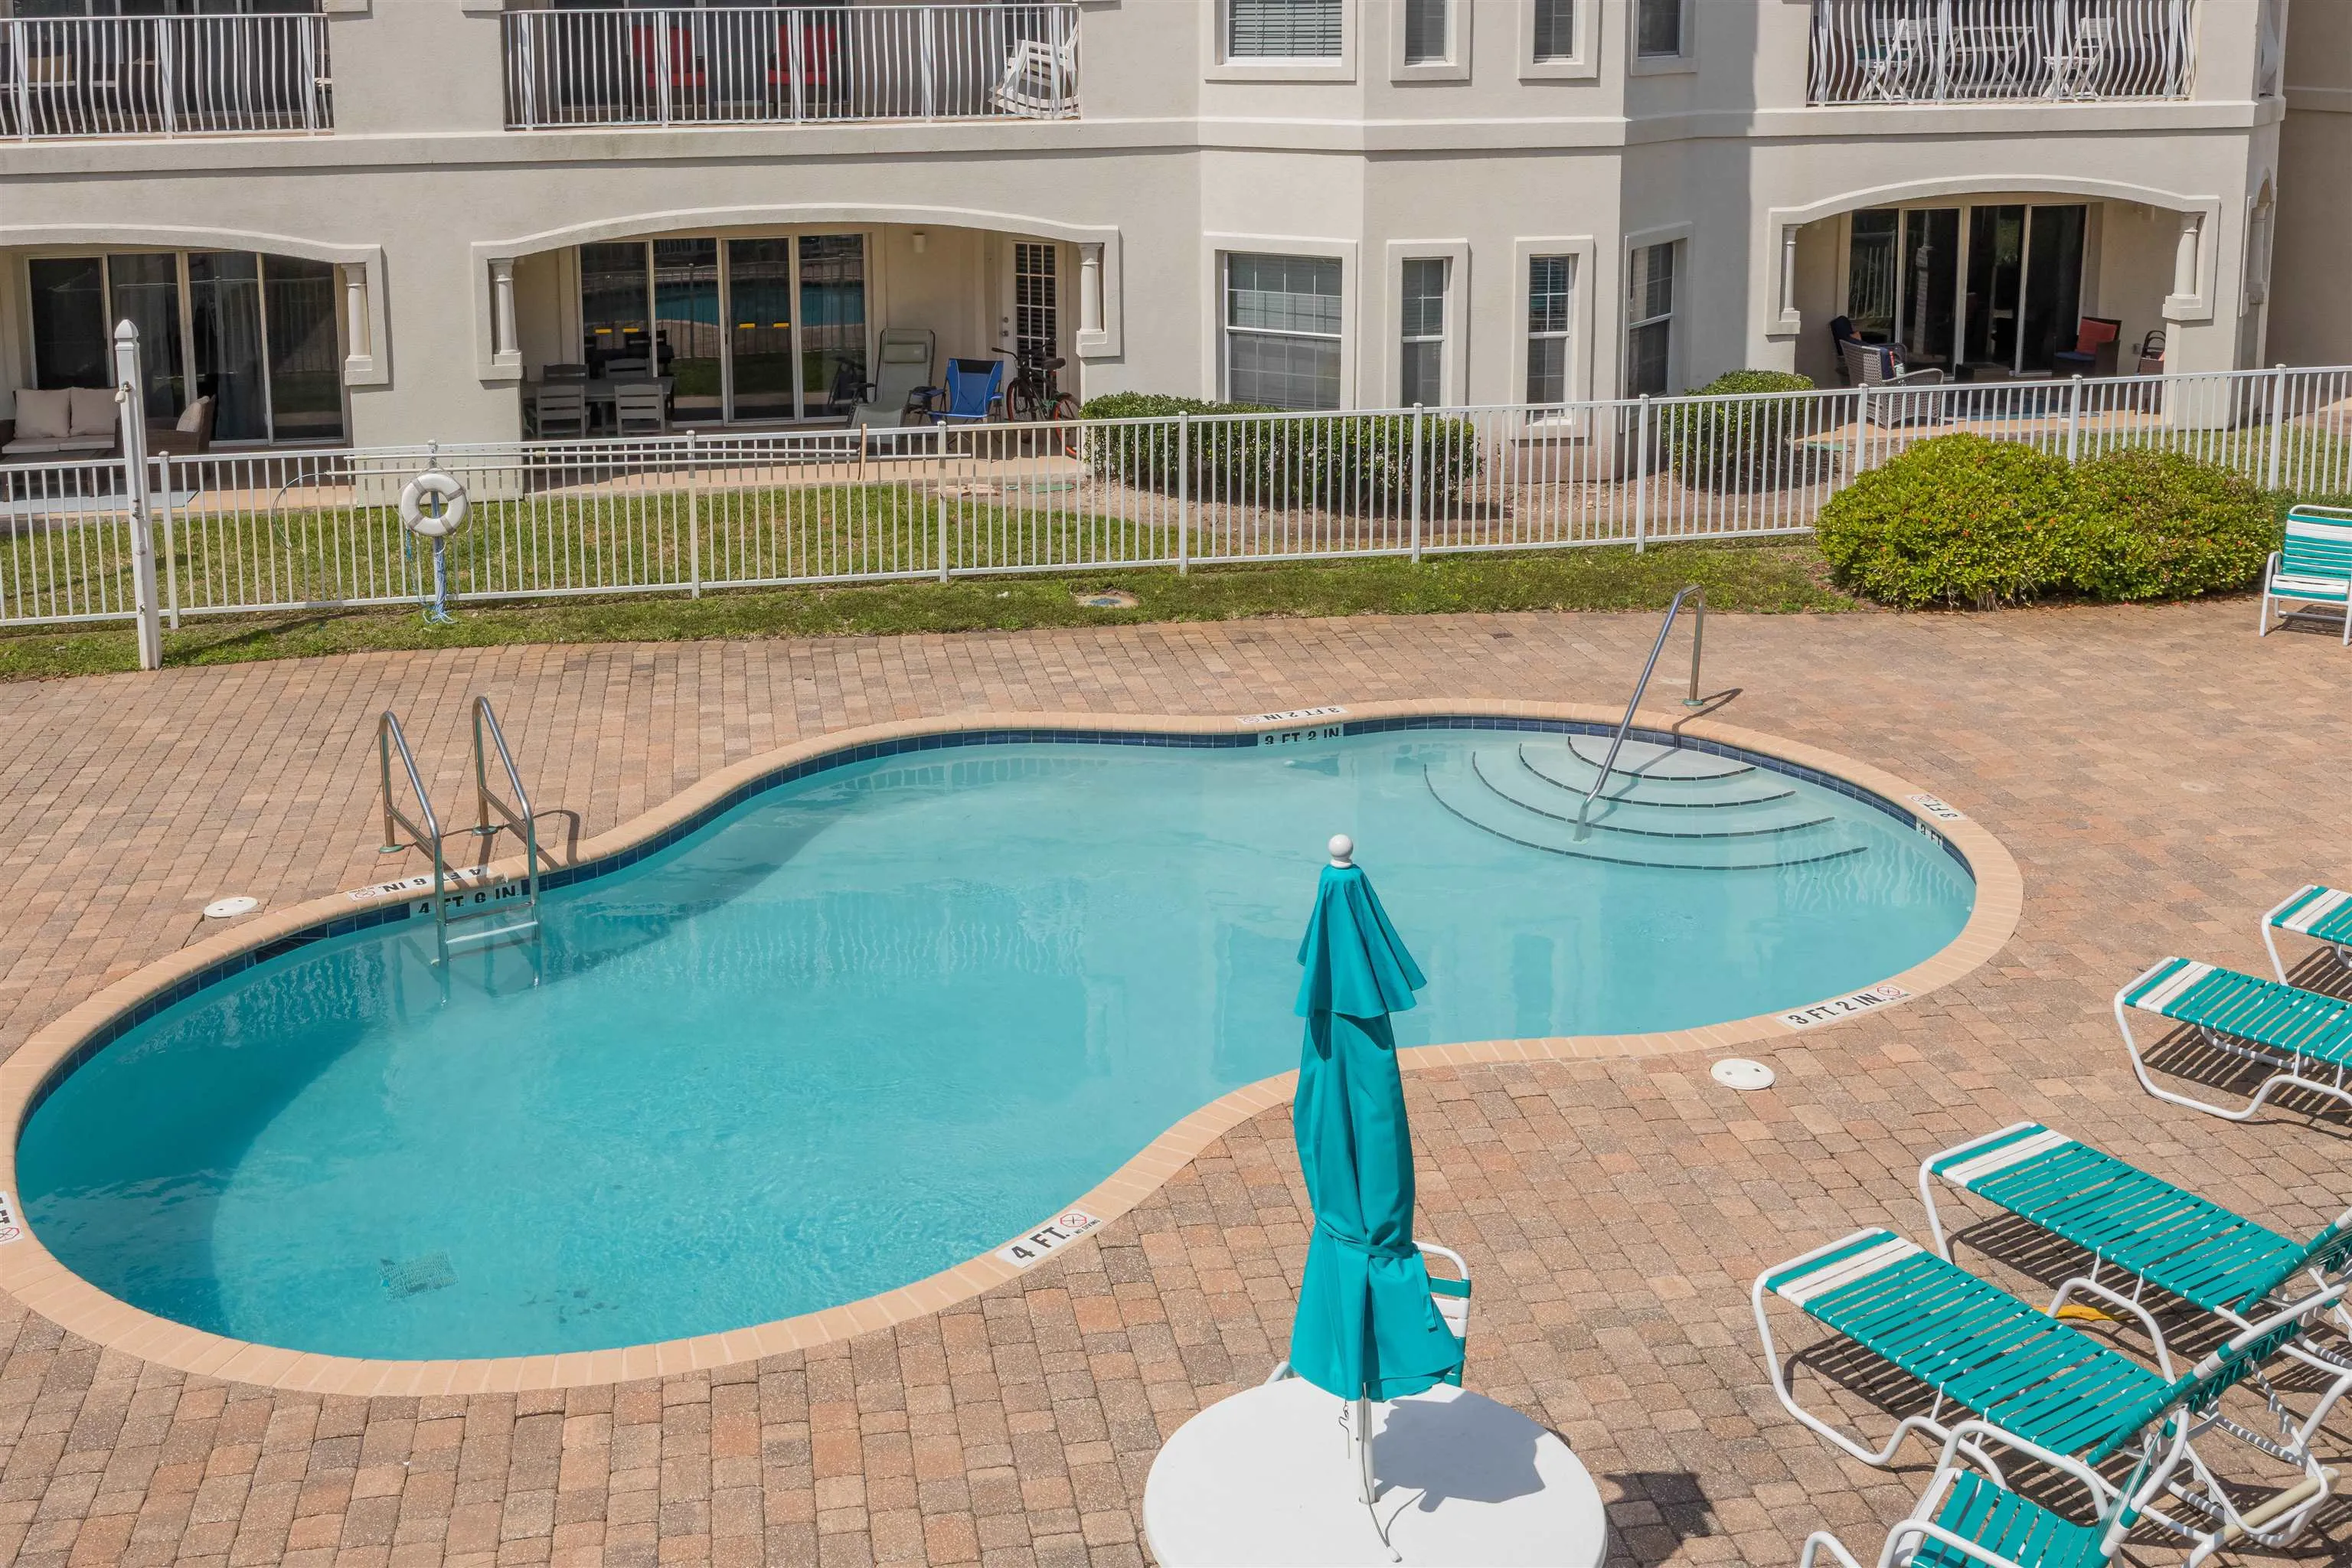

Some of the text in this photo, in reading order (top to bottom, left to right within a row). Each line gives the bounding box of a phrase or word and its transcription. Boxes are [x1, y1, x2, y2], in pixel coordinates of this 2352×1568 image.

[1265, 735, 1274, 745] 3
[1308, 730, 1317, 740] 2
[418, 902, 430, 913] 4
[1788, 1014, 1809, 1024] 3
[1835, 1001, 1857, 1011] 2
[1852, 993, 1886, 1006] IN.
[1011, 1226, 1070, 1259] 4 FT.
